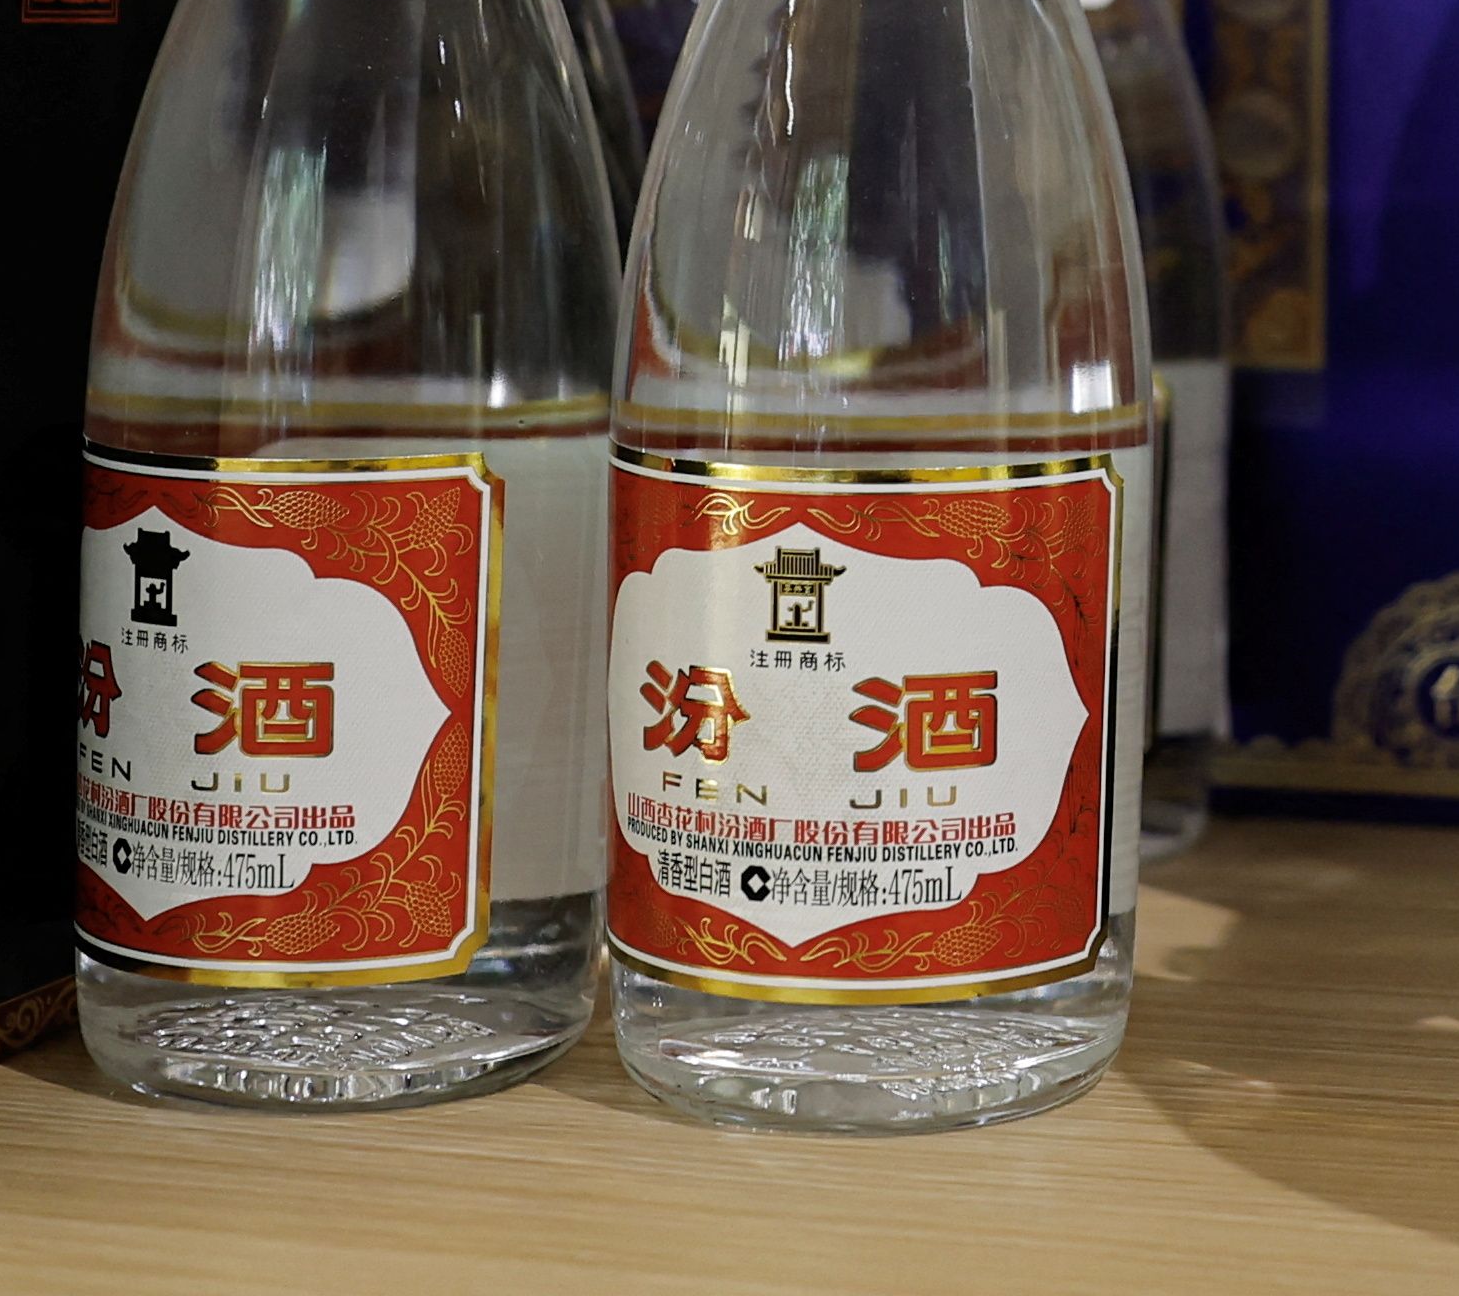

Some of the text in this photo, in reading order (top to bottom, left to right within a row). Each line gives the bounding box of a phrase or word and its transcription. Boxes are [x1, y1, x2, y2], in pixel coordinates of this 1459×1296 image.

[191, 661, 335, 758] 酒
[639, 659, 998, 773] 汾 酒
[662, 770, 958, 810] FEN JIU
[172, 827, 213, 845] FENJIU
[217, 831, 294, 847] DISTILLERY
[627, 792, 1017, 846] 山西杏花村汾酒厂股份有限公司出品
[627, 815, 668, 842] PRODUCED
[686, 837, 729, 855] SHANXI
[732, 838, 822, 862] XINGHUACUN
[827, 846, 878, 863] FENJIU
[882, 843, 961, 862] DISTILLERY
[656, 850, 731, 899] 清香型白酒
